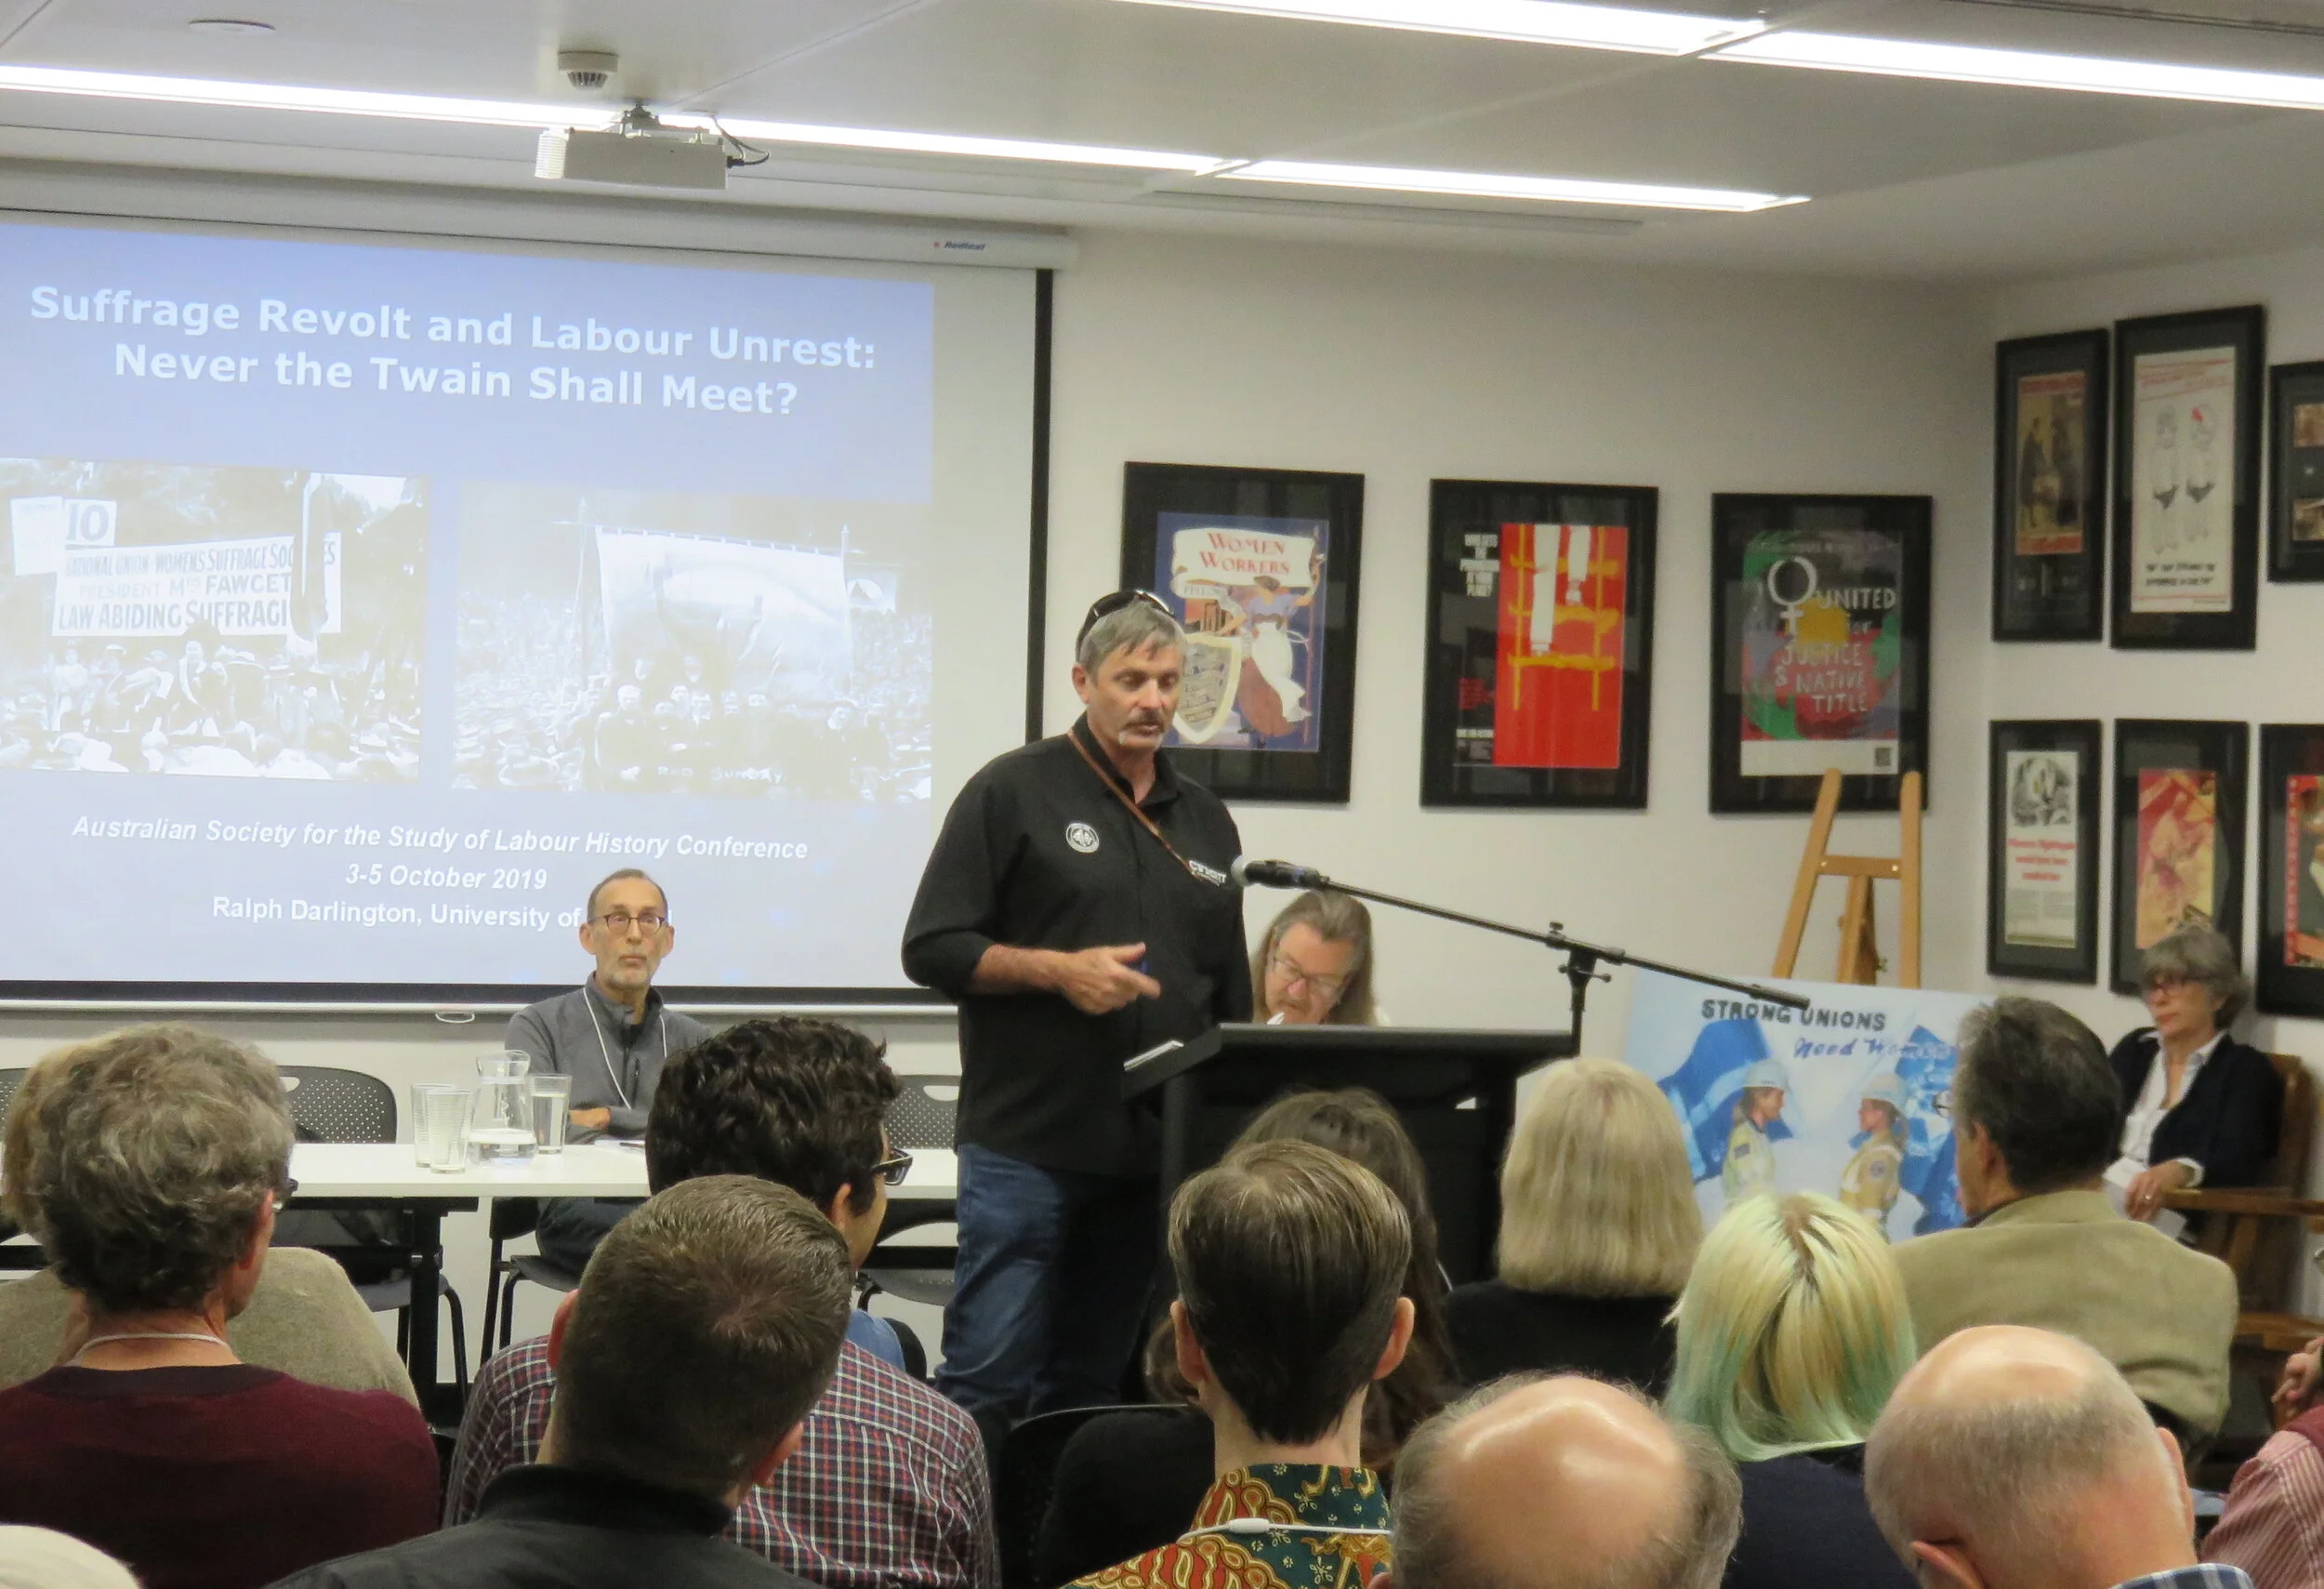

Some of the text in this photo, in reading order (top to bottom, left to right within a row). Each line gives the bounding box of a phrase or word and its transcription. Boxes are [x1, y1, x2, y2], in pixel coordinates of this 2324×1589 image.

[31, 285, 875, 368] Suffrage Revolt and Labour Unrest:
[115, 343, 798, 414] Never the Twain Shall Meet?
[1207, 532, 1286, 554] WOMEN
[1199, 551, 1290, 575] WORKERS
[205, 574, 290, 595] FAWCET
[1816, 587, 1896, 610] UNITED
[59, 604, 93, 629] LAW
[99, 603, 182, 629] ABIDING
[72, 815, 808, 860] Australian Society for the Study of Labour History Conference
[346, 863, 547, 890] 3-5 October 2019
[213, 896, 582, 933] Ralph Darlington, University of
[1701, 999, 1886, 1031] STRONG UNIONS
